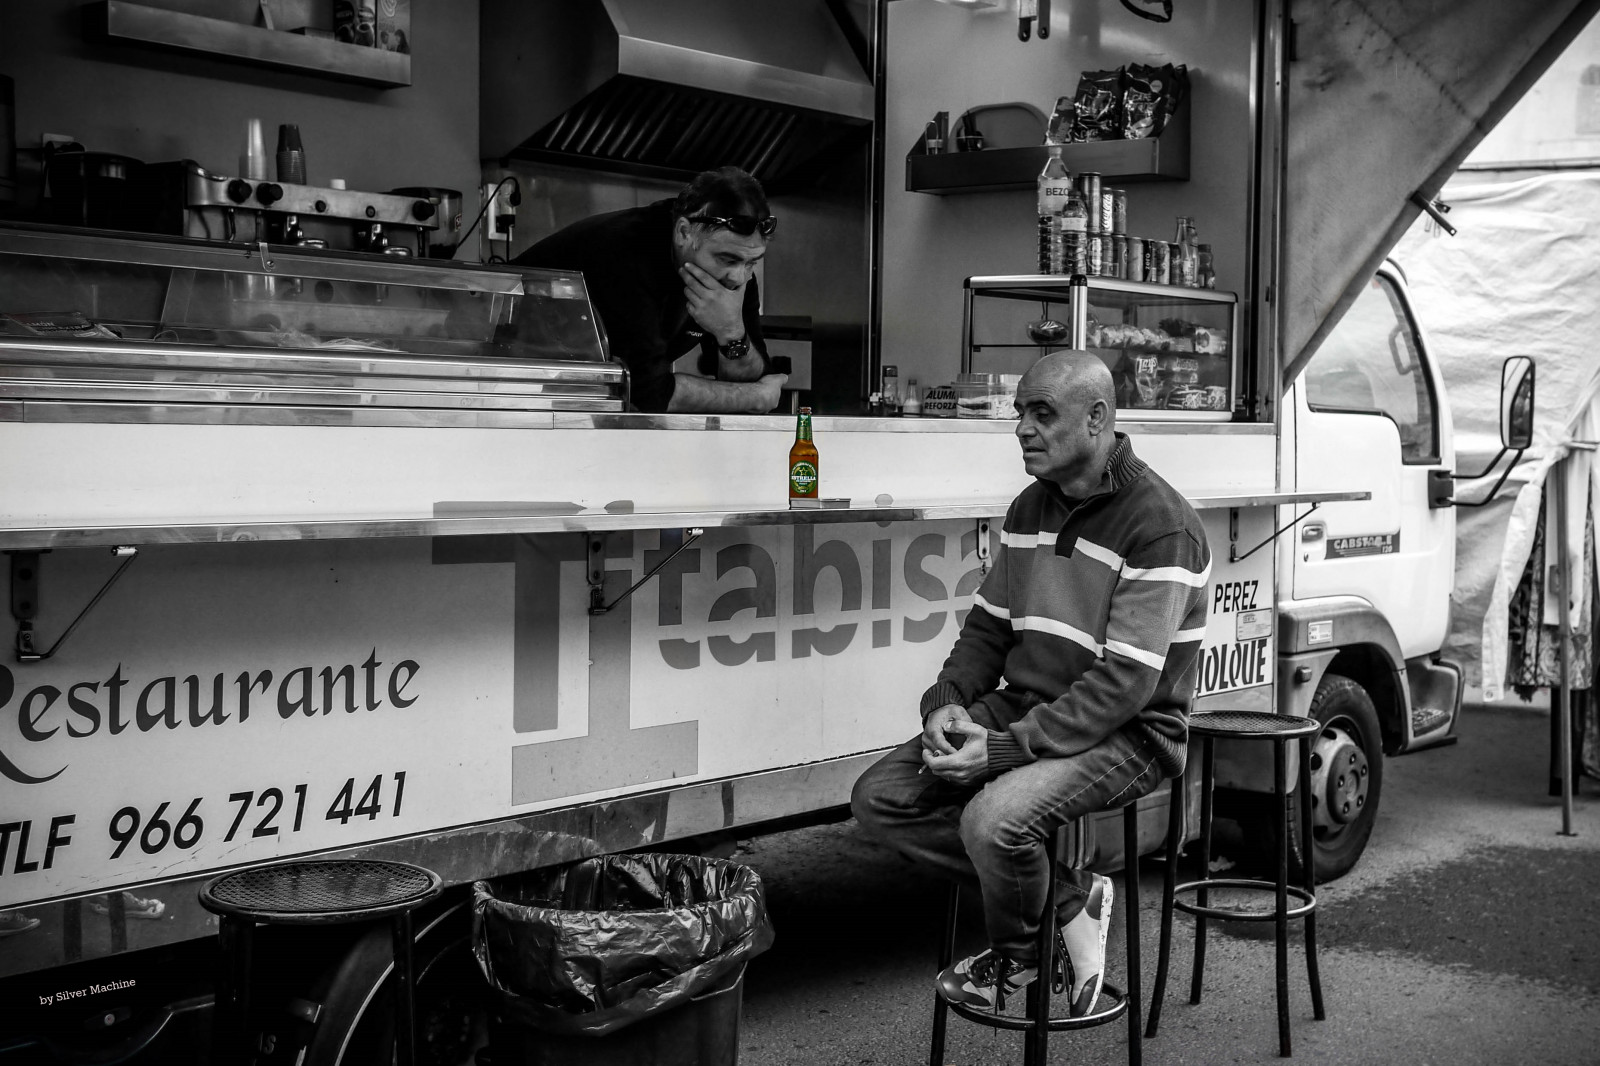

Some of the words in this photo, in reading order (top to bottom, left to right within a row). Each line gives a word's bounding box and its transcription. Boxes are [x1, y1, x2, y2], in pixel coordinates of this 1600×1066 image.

[1213, 580, 1259, 614] PEREZ
[0, 814, 76, 877] TLF
[108, 797, 204, 860] 966
[223, 783, 309, 842] 721
[325, 770, 407, 825] 441
